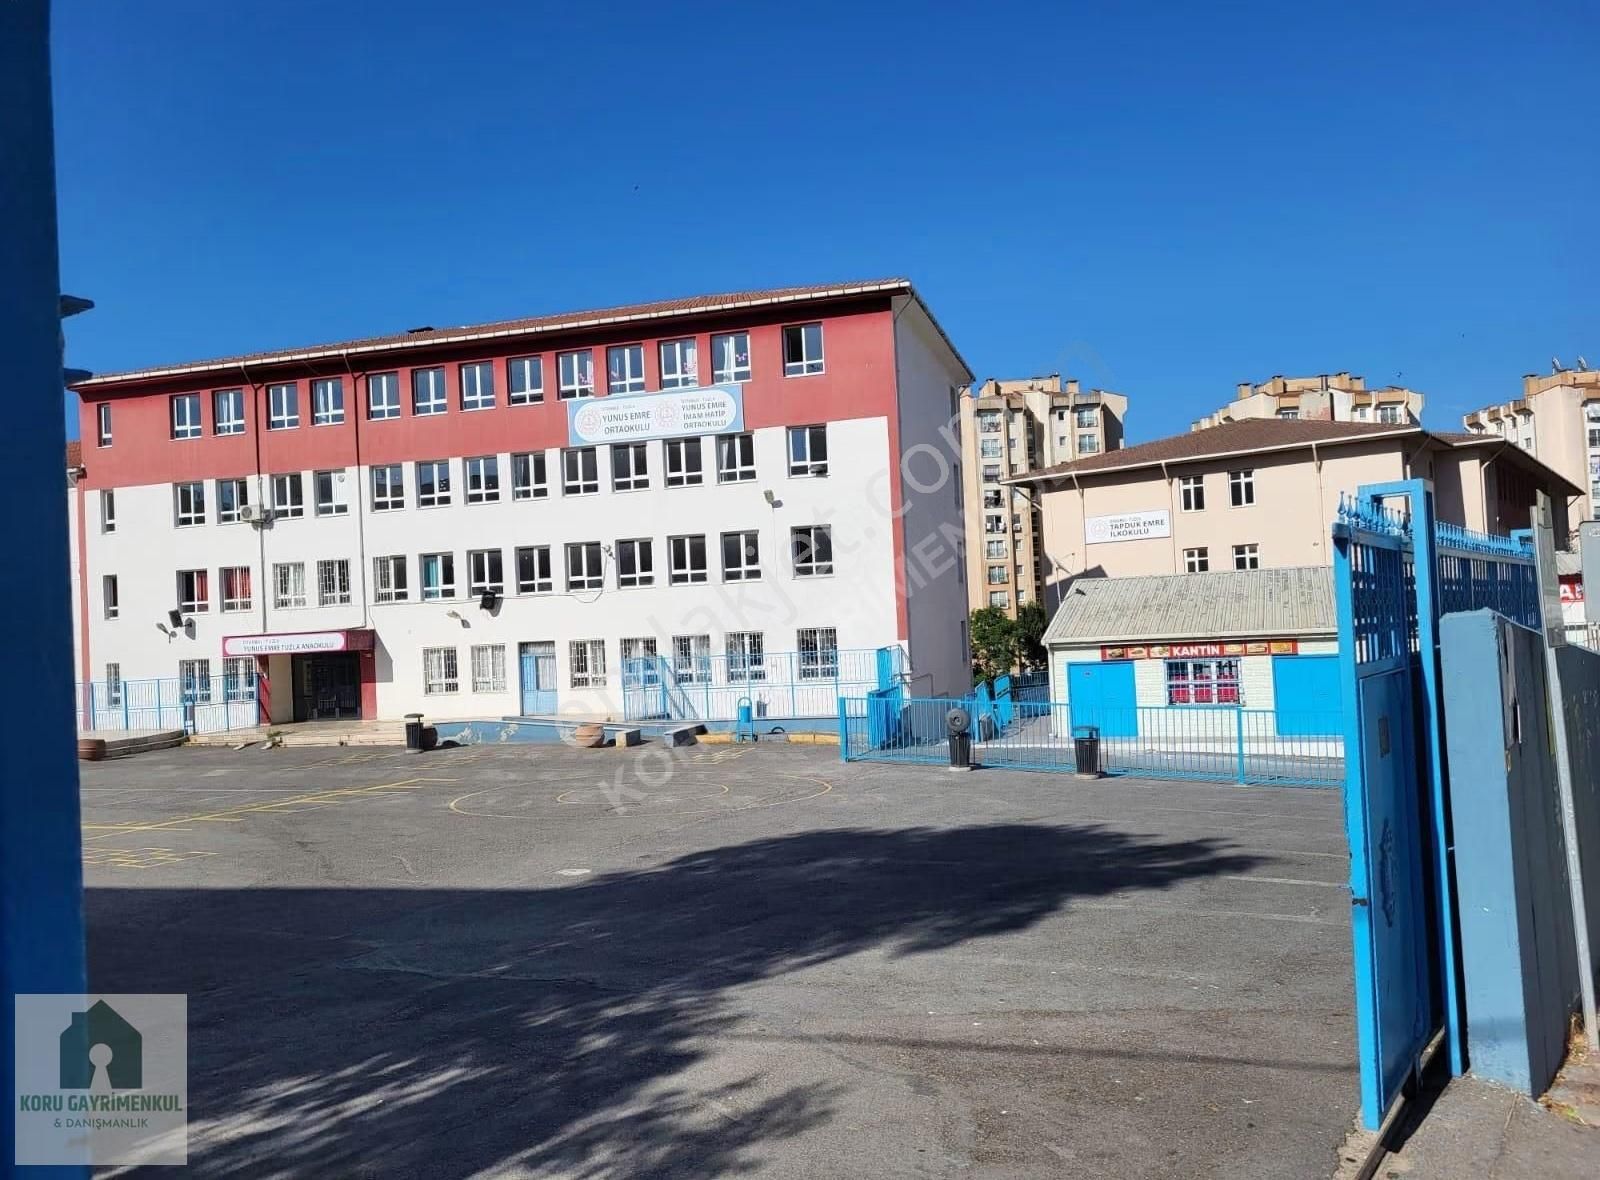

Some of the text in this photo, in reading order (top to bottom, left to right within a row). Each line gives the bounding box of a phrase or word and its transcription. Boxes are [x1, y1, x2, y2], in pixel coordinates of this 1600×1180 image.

[682, 402, 706, 411] YUNUS
[602, 410, 651, 423] YUNUS EMRE
[604, 422, 650, 435] ORTAOKULU
[683, 419, 727, 430] ORTAOKULU
[1110, 521, 1141, 530] TAPDUK
[1143, 518, 1165, 527] EMRE
[281, 643, 300, 651] TUZLA
[1172, 644, 1220, 656] KANTİN
